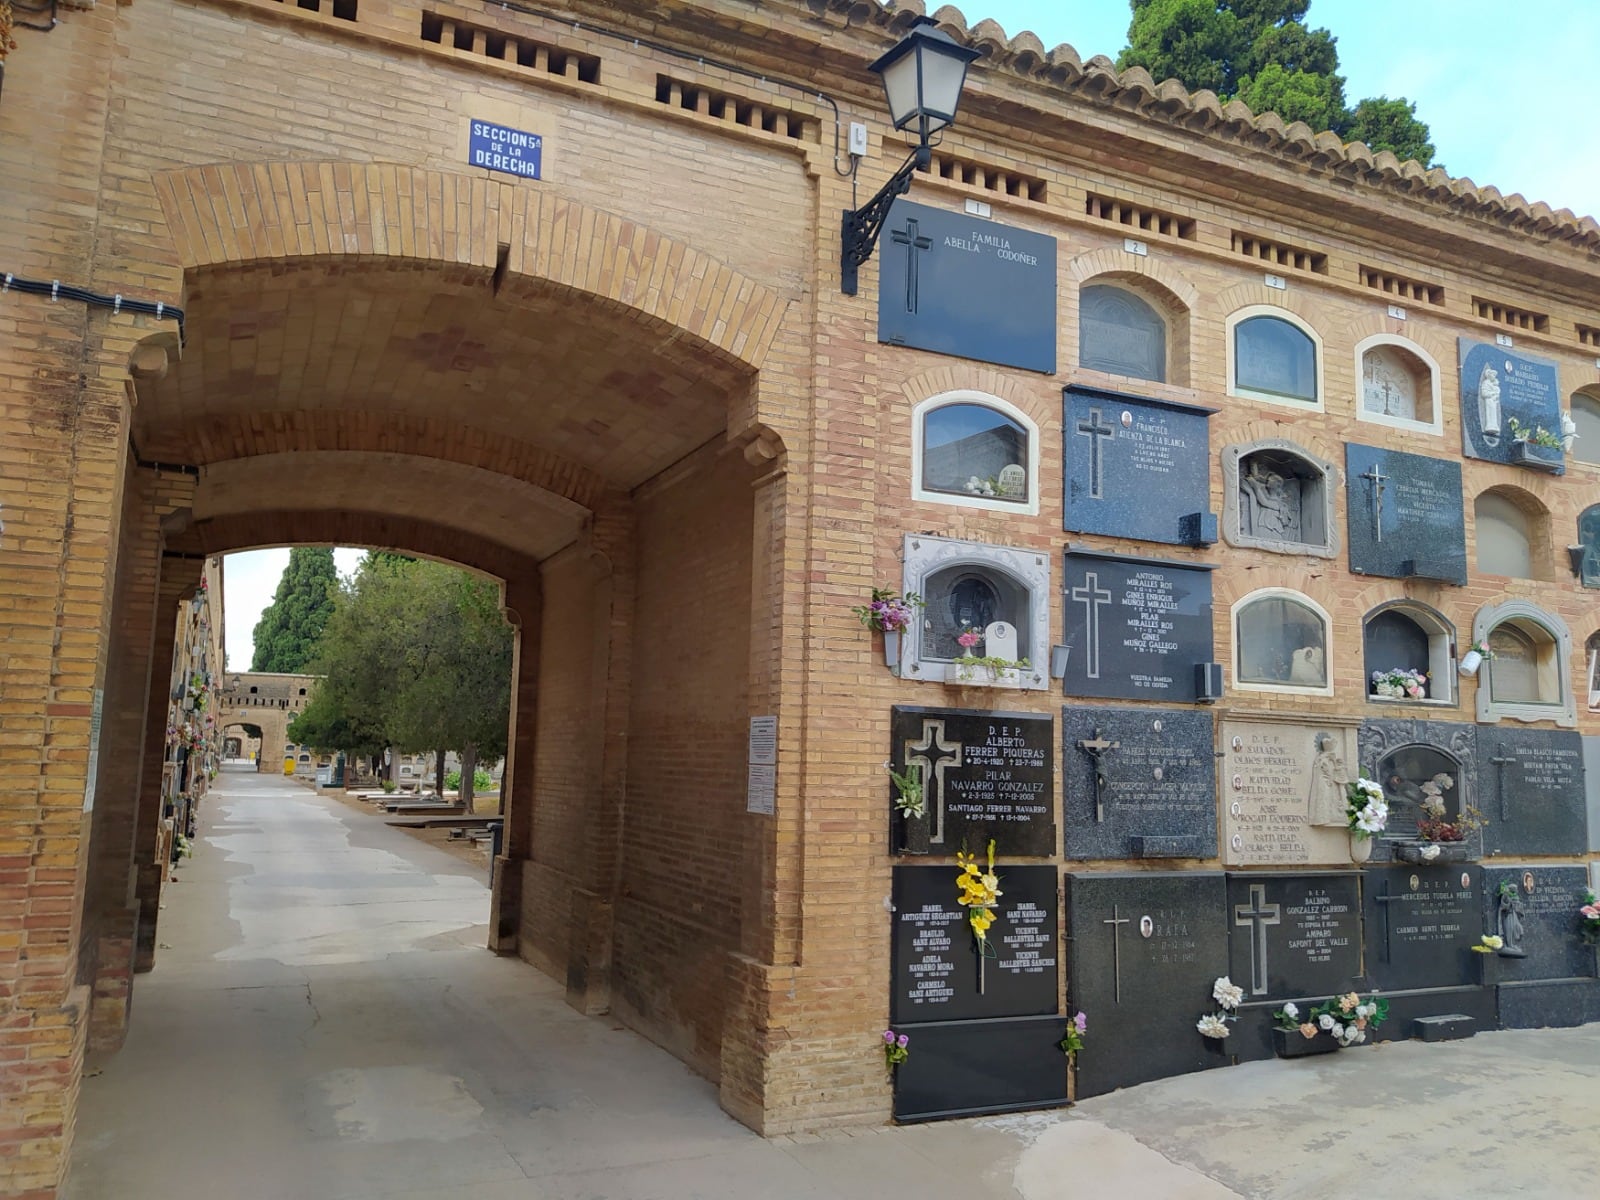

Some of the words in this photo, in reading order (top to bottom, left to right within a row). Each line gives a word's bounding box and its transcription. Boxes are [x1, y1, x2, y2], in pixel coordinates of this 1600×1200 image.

[474, 124, 527, 147] SECCION
[491, 142, 503, 153] DE
[509, 147, 521, 157] LA
[476, 149, 535, 175] DERECHA
[972, 231, 1011, 250] FAMILIA
[944, 236, 980, 253] ABELLA
[997, 248, 1038, 266] CODOÑER
[1133, 242, 1138, 253] 2
[1155, 436, 1163, 445] LA
[1135, 572, 1163, 580] ANTONIO
[1126, 578, 1157, 588] MIRALLES
[1125, 591, 1145, 599] GINES
[1146, 593, 1173, 602] ENRIQUE
[1147, 601, 1178, 610] MIRALLES
[1140, 612, 1159, 621] PILAR
[1127, 619, 1158, 628] MIRALLES
[1160, 621, 1173, 629] ROS
[1141, 632, 1160, 641] GINES
[1123, 639, 1147, 648] MUÑOZ
[1148, 640, 1178, 650] GALLEGO
[985, 737, 1025, 748] ALBERTO
[964, 747, 998, 757] FERRER
[1003, 748, 1045, 759] PIQUERAS
[985, 771, 1012, 781] PILAR
[951, 781, 994, 791] NAVARRO
[998, 782, 1044, 793] GONZALEZ
[948, 804, 984, 812] SANTIAGO
[987, 805, 1012, 813] FERRER
[1015, 805, 1047, 814] NAVARRO
[1401, 892, 1430, 901] MERCEDES
[1432, 892, 1454, 900] TUDELA
[1456, 891, 1473, 899] PEREZ
[922, 904, 943, 912] ISABEL
[1286, 906, 1319, 915] GONZALEZ
[1321, 905, 1348, 913] CARRION
[901, 913, 930, 921] ARTIGUEZ
[1021, 910, 1047, 918] NAVARRO
[1156, 924, 1189, 937] RAFA
[1305, 930, 1332, 938] AMPARO
[1396, 926, 1419, 934] CARMEN
[1440, 924, 1460, 932] TUDELA
[929, 938, 951, 946] ALVARO
[1003, 935, 1035, 943] BALLESTER
[1315, 938, 1327, 947] DEL
[1330, 937, 1349, 946] VALLE
[922, 955, 942, 963] ADELA
[1015, 951, 1039, 959] VICENTE
[908, 964, 936, 972] NAVARRO
[999, 960, 1030, 968] BALLESTER
[917, 981, 945, 989] CARMELO
[925, 989, 954, 997] ARTIGUEZ
